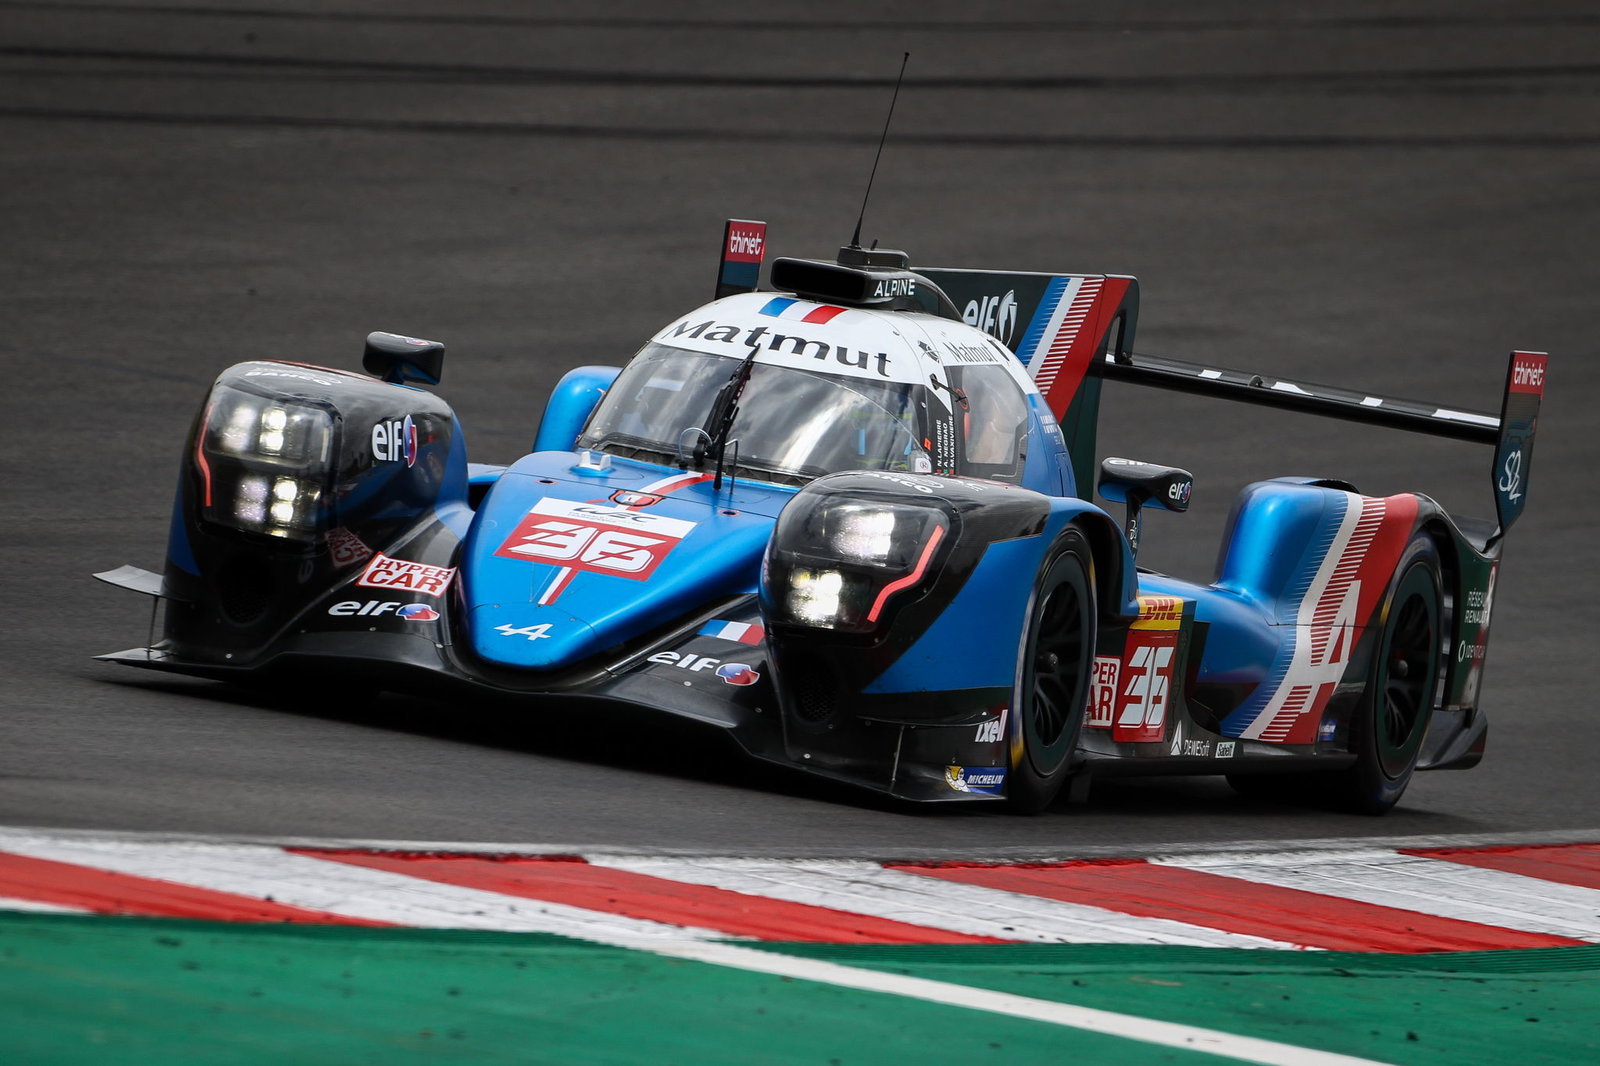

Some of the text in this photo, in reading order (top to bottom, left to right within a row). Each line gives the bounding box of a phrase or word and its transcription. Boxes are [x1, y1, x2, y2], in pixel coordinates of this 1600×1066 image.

[730, 230, 762, 255] thiriet
[874, 279, 916, 297] ALPINE
[962, 295, 1000, 335] elf
[660, 320, 892, 378] Matmut
[943, 342, 998, 363] Matmut
[1513, 361, 1544, 386] thiriet
[371, 420, 403, 462] elf
[1168, 482, 1185, 500] elf
[507, 520, 667, 573] 36
[375, 558, 453, 580] HYPER
[366, 569, 444, 593] CAR
[328, 600, 402, 617] elf
[1143, 599, 1178, 621] DHL
[647, 651, 721, 673] elf
[1093, 662, 1117, 685] PER
[1118, 646, 1175, 729] 36
[1086, 684, 1113, 721] AR
[967, 774, 1005, 785] MICHELIN
